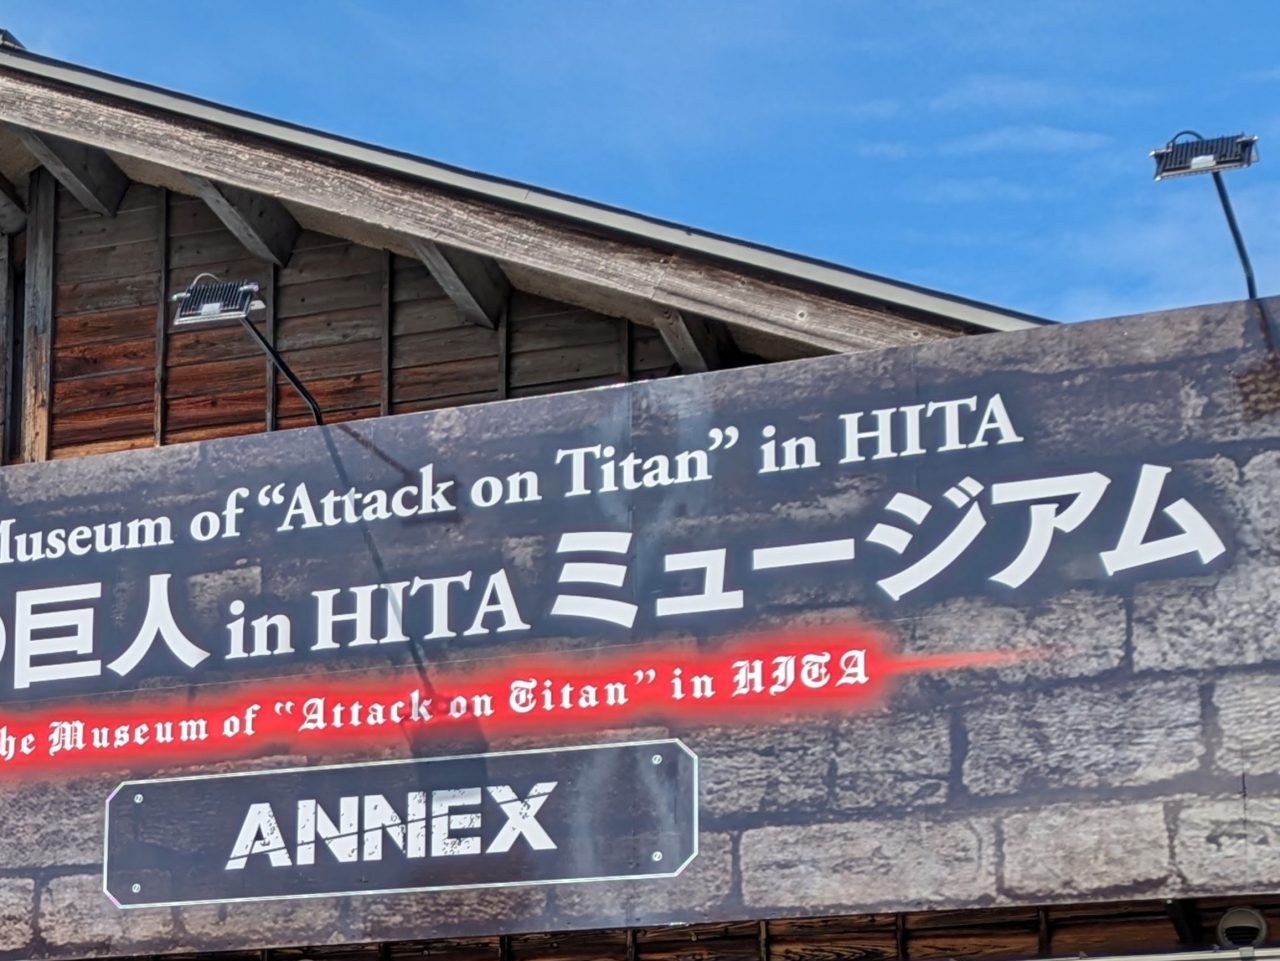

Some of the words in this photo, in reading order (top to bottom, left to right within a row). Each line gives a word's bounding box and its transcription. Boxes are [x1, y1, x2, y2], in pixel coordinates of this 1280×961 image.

[190, 487, 250, 541] of
[471, 471, 542, 507] on
[759, 425, 821, 473] in
[839, 394, 1024, 464] HITA
[225, 600, 295, 659] in
[311, 568, 531, 651] HITA
[551, 464, 1226, 628] ミュージアム
[48, 719, 208, 756] Museum
[222, 704, 260, 741] of
[450, 694, 493, 718] on
[671, 668, 715, 701] in
[732, 650, 869, 696] HITA
[225, 781, 558, 870] ANNEX
